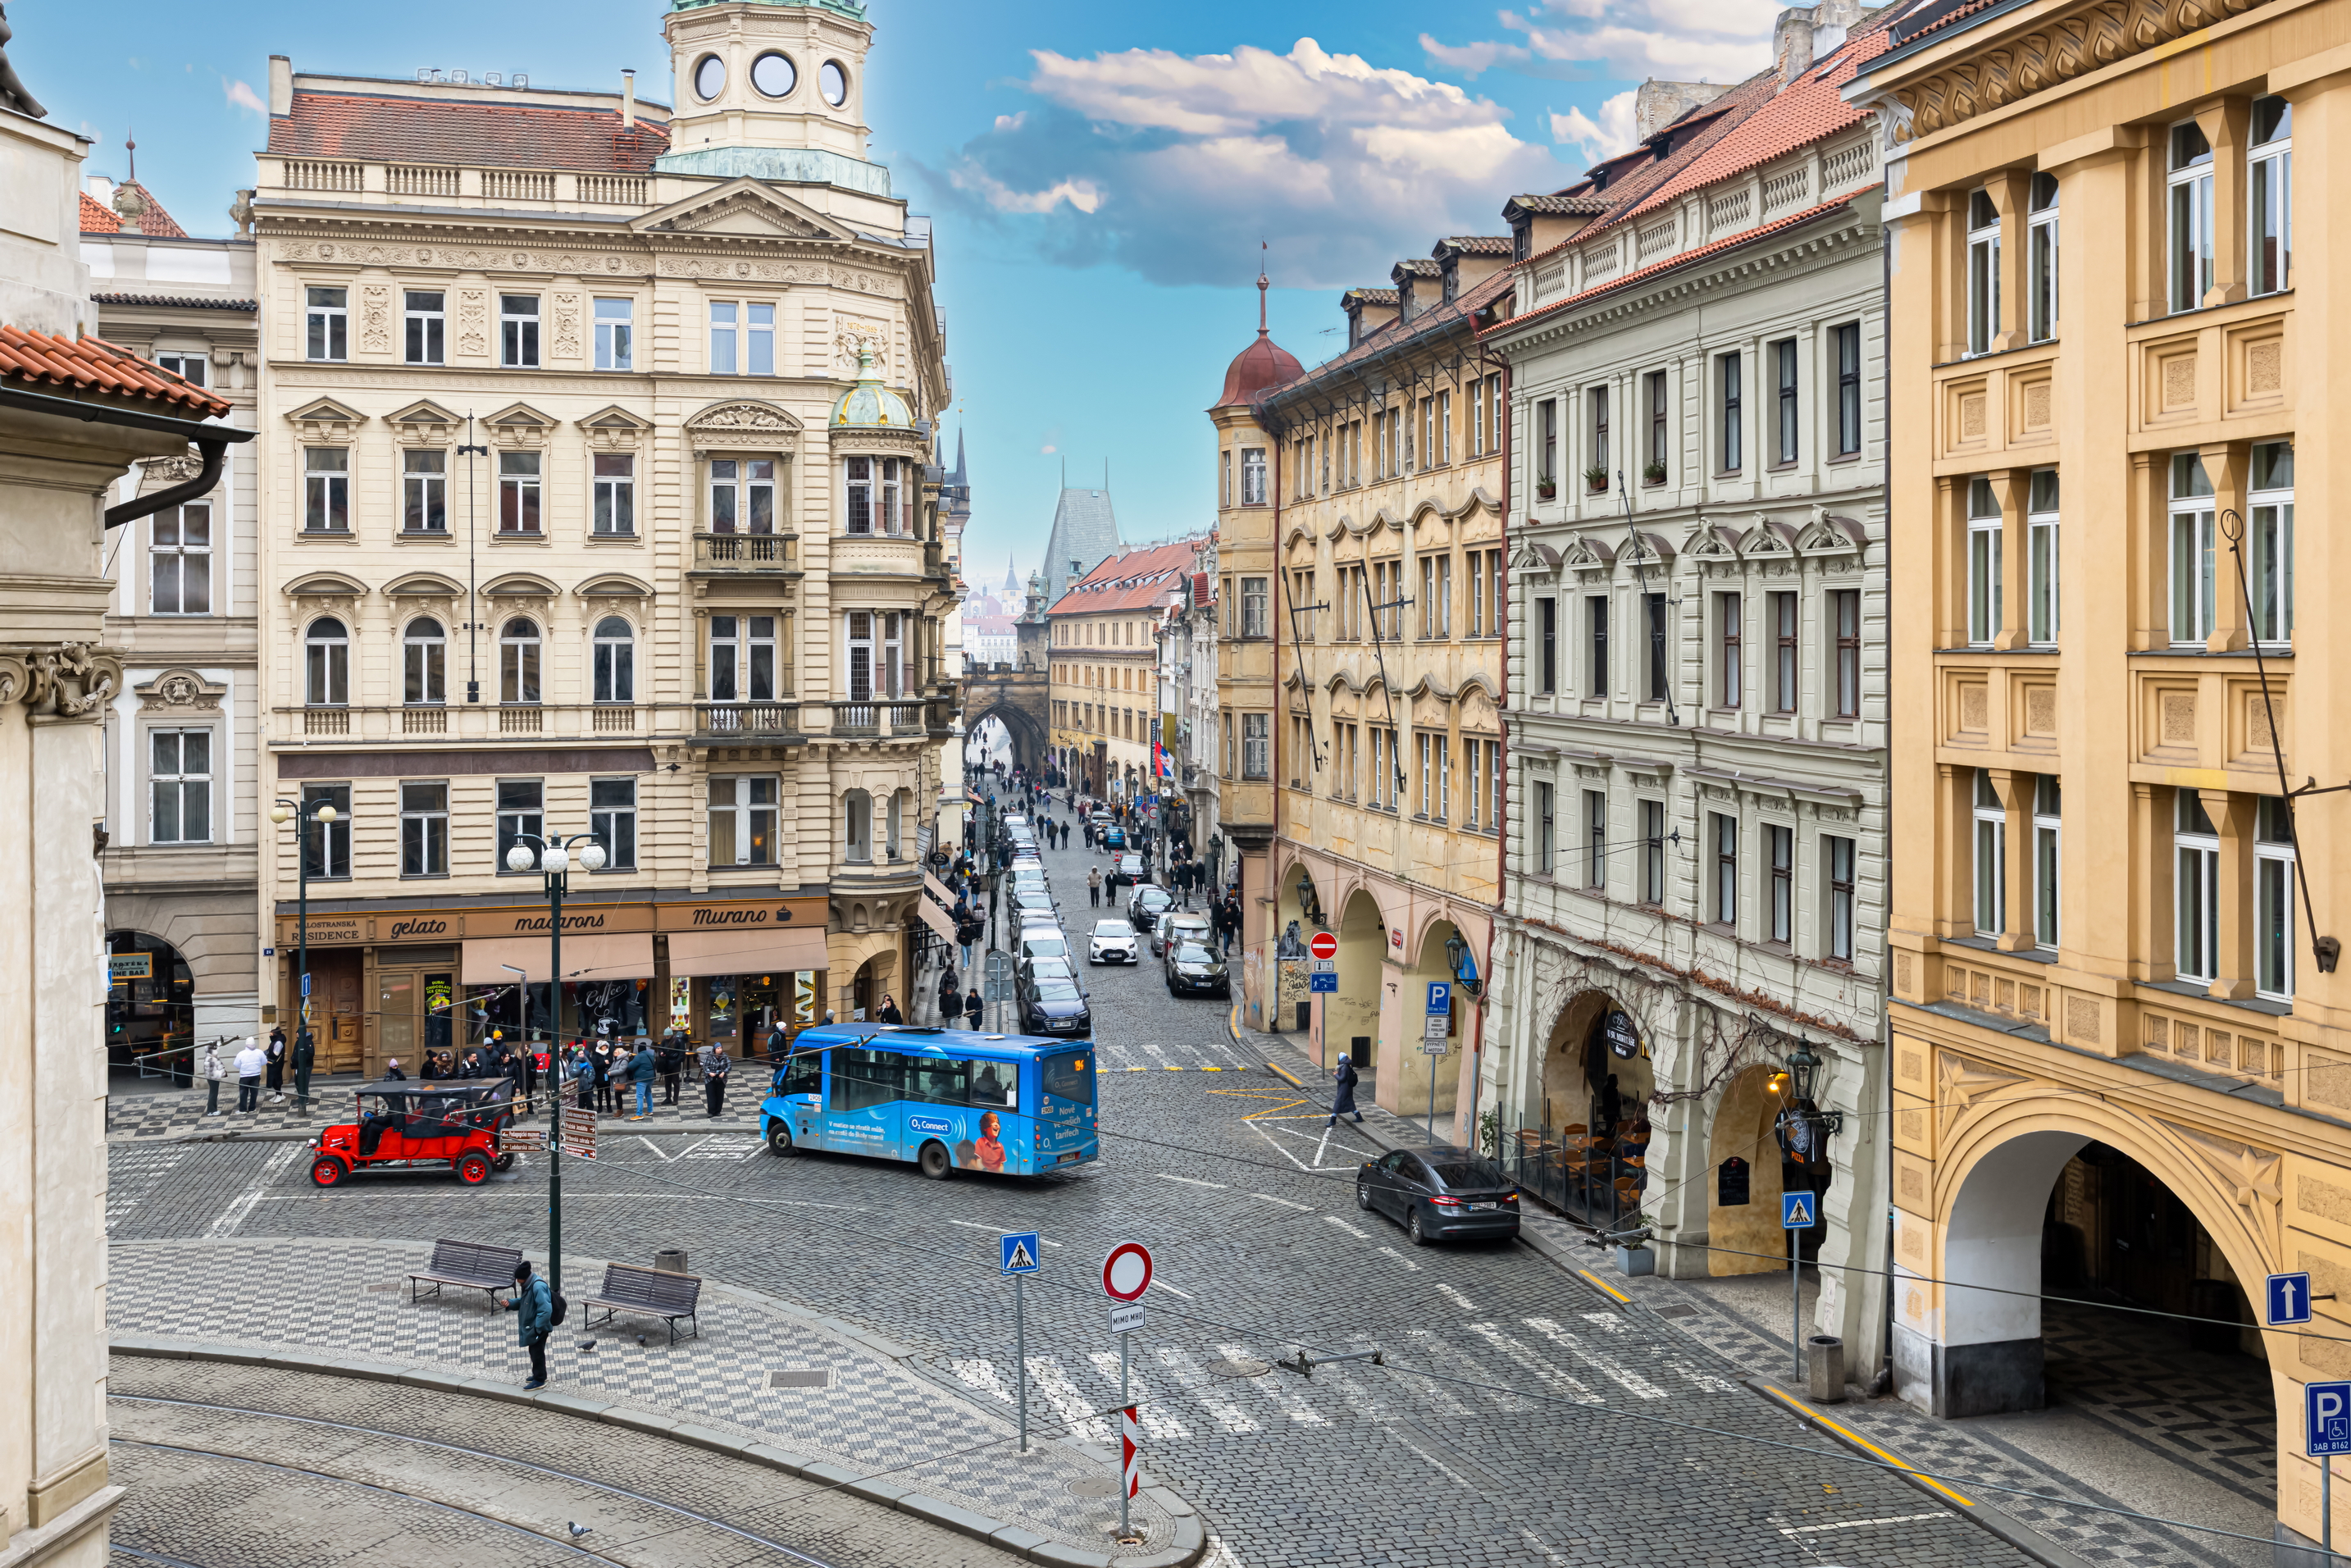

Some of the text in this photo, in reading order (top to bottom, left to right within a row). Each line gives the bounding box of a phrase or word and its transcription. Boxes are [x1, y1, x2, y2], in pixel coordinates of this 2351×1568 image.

[693, 909, 767, 925] Murano
[295, 919, 357, 928] MLOSTRANSKÁ
[390, 918, 446, 938] gelato
[292, 930, 359, 941] RSIDENCE
[586, 981, 626, 1008] Coffee
[1432, 986, 1445, 1005] P
[1061, 1079, 1078, 1087] Connect
[922, 1121, 948, 1131] Connect
[1062, 1115, 1081, 1126] vašich
[855, 1132, 868, 1140] školy
[1055, 1128, 1079, 1140] tarifech
[1792, 1151, 1804, 1164] PIZZA
[1114, 1312, 1142, 1325] MIMO MHD
[2317, 1393, 2342, 1433] P
[2313, 1441, 2349, 1451] 3AB 8162
